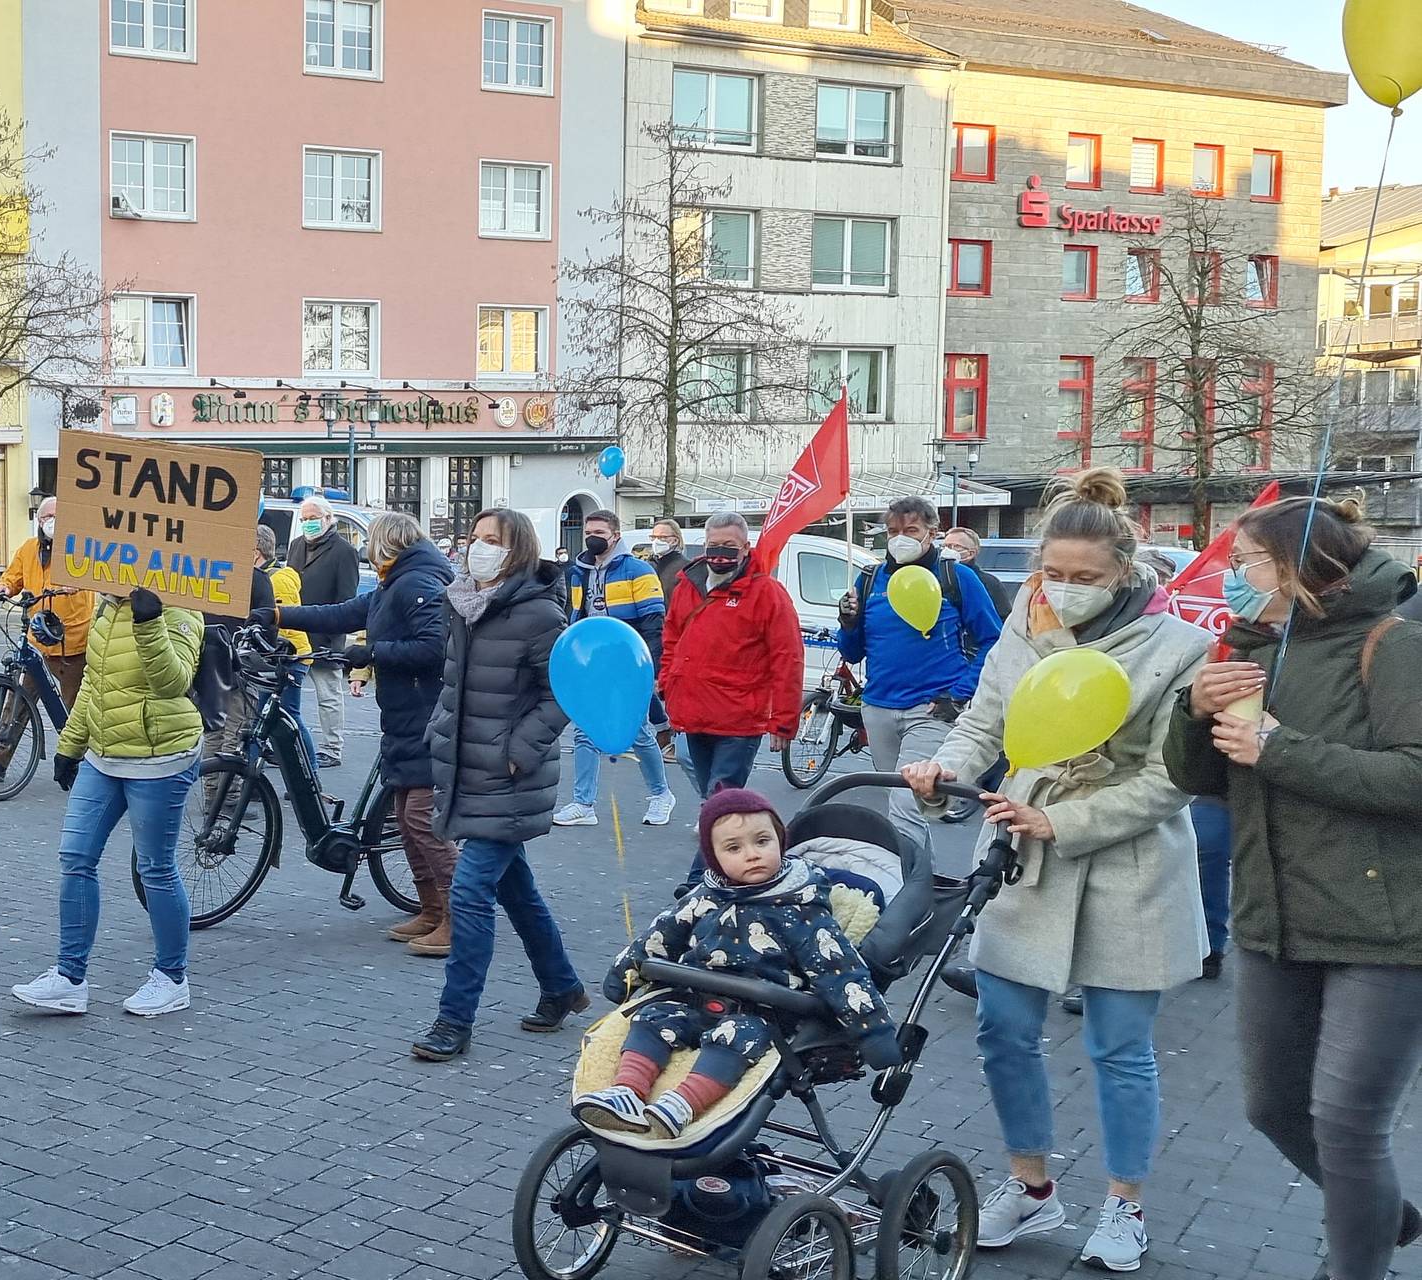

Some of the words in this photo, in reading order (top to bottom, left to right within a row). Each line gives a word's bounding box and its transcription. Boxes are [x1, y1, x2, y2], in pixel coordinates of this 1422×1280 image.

[1059, 204, 1163, 236] Sparkasse
[75, 448, 238, 512] STAND
[101, 506, 184, 544] WITH
[64, 533, 234, 604] UKRAINE
